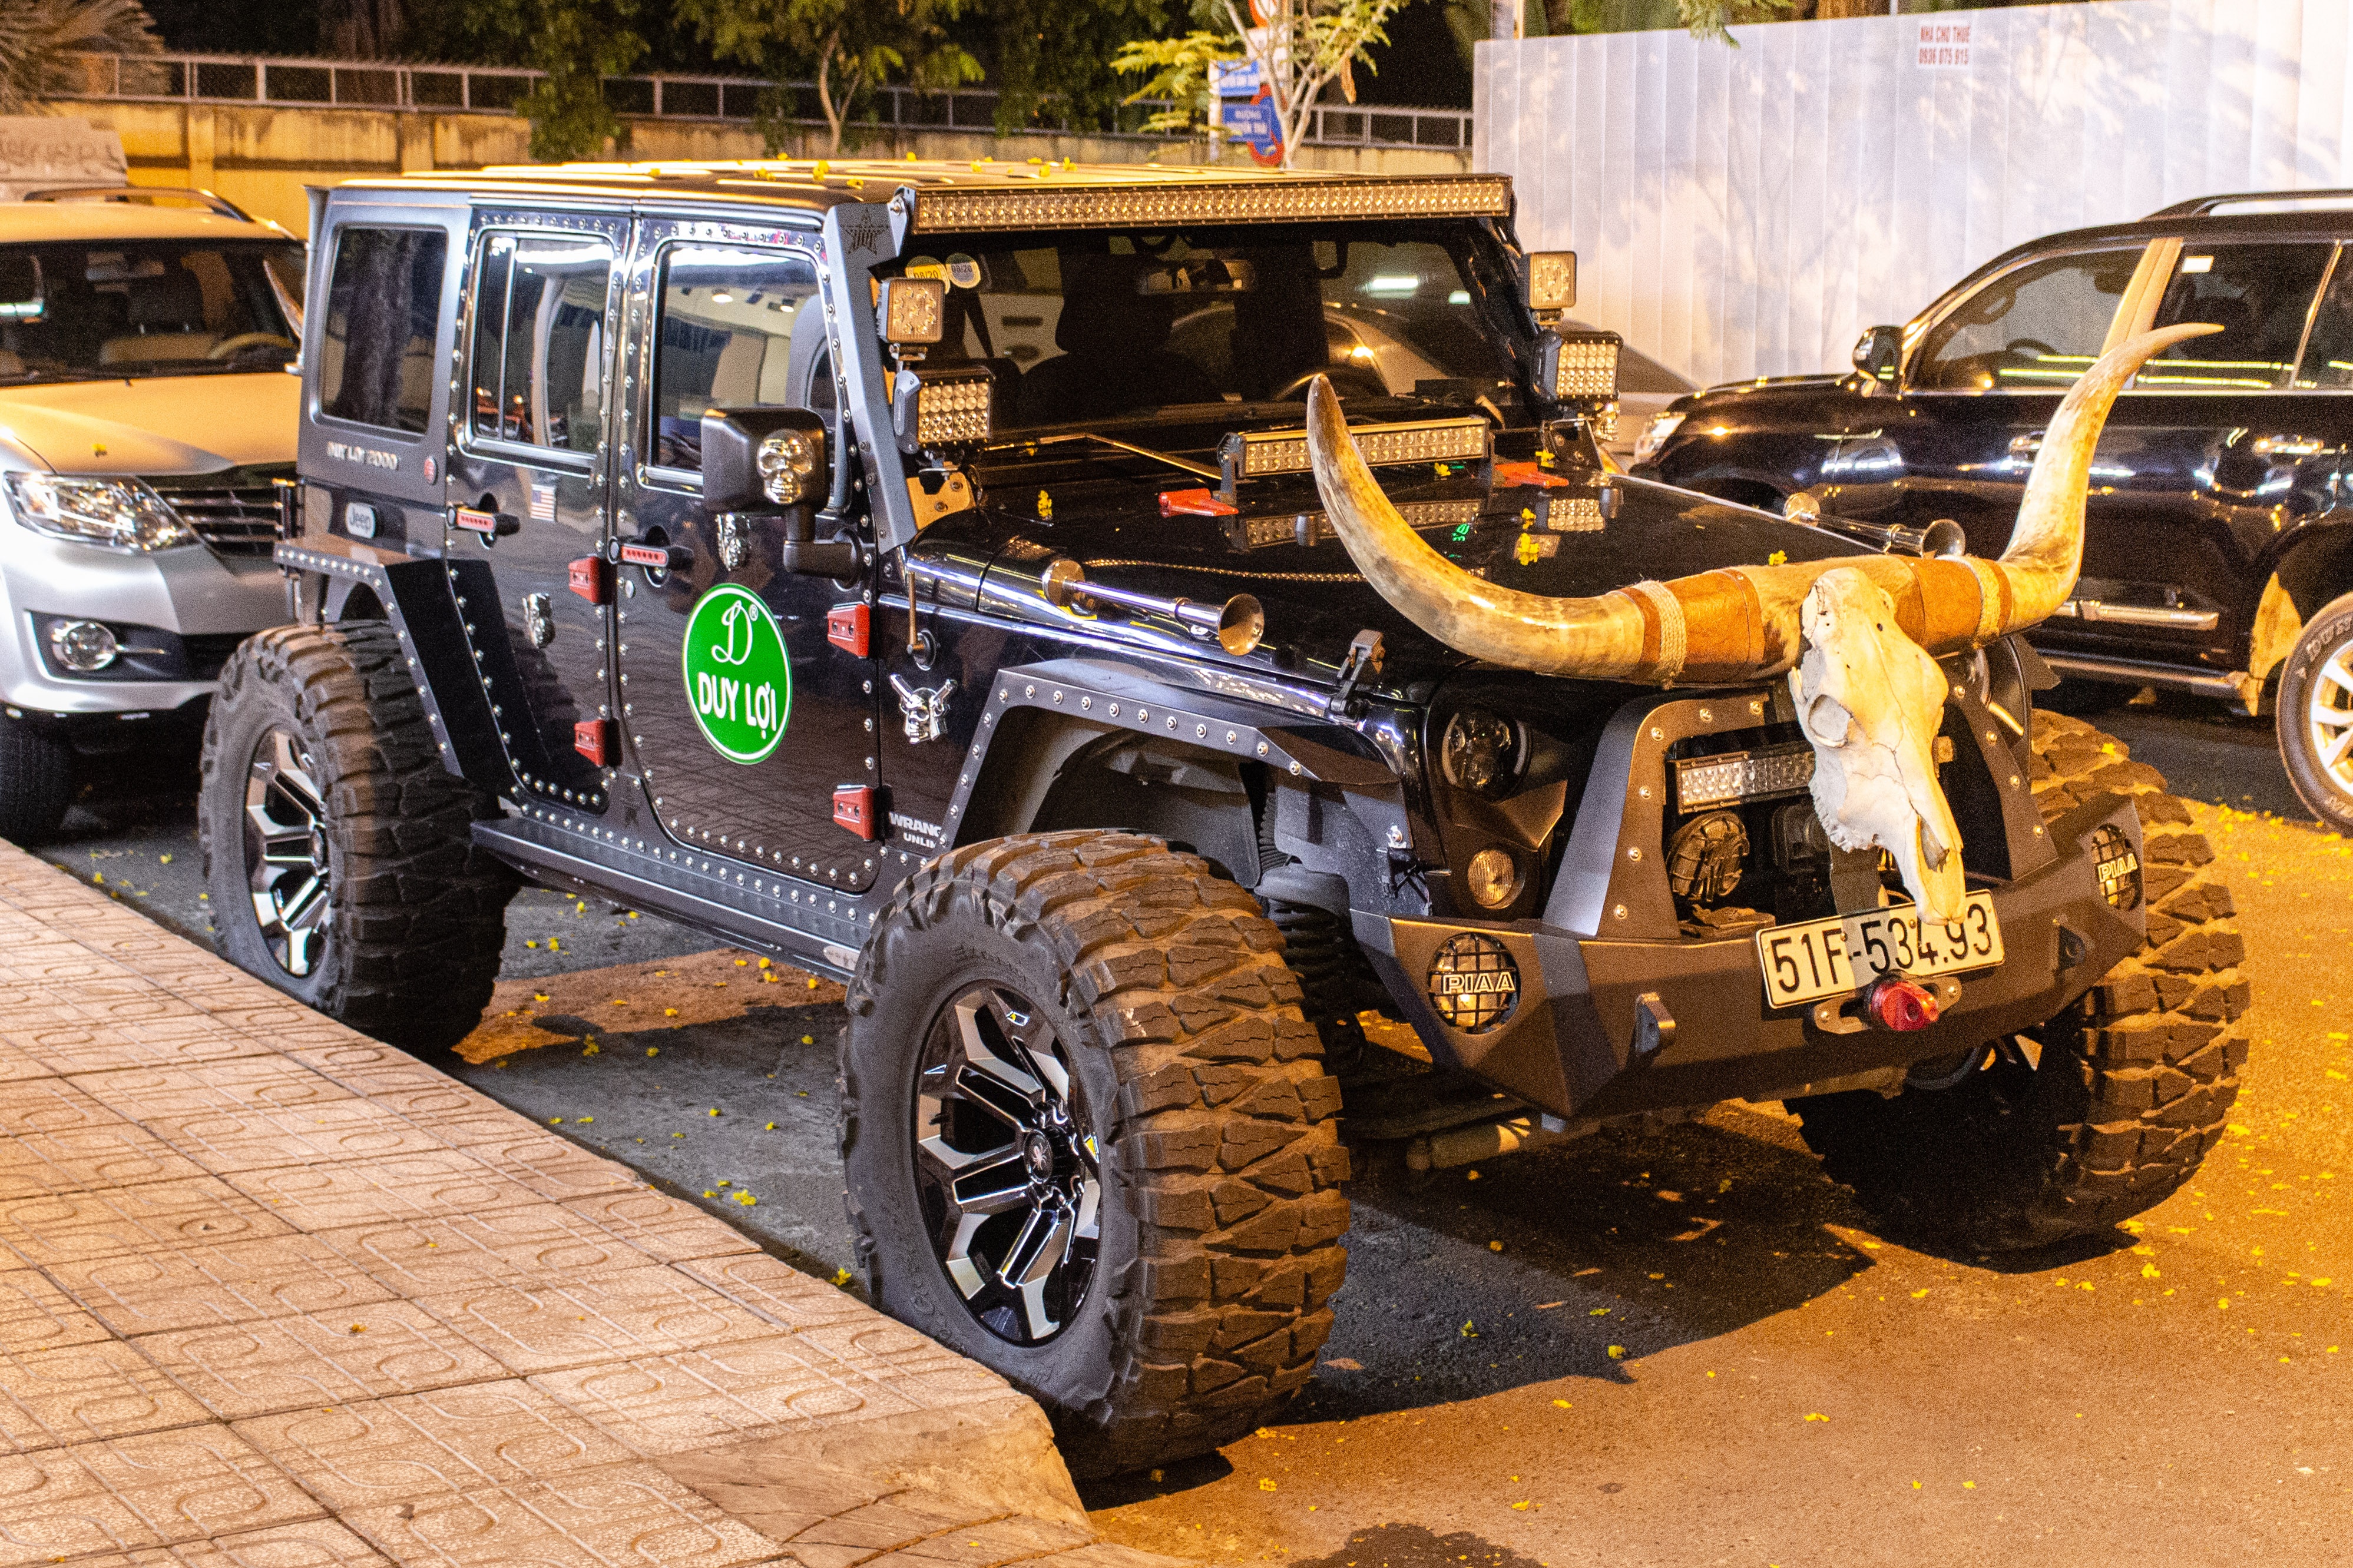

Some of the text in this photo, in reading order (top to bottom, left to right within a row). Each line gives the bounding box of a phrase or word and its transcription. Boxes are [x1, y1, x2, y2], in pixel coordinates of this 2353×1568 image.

[349, 507, 370, 533] Jeep
[698, 671, 777, 740] DUY LỢI
[2097, 853, 2137, 883] PIAA
[1769, 903, 1992, 993] 51F-534.93
[1443, 972, 1515, 994] PIAA
